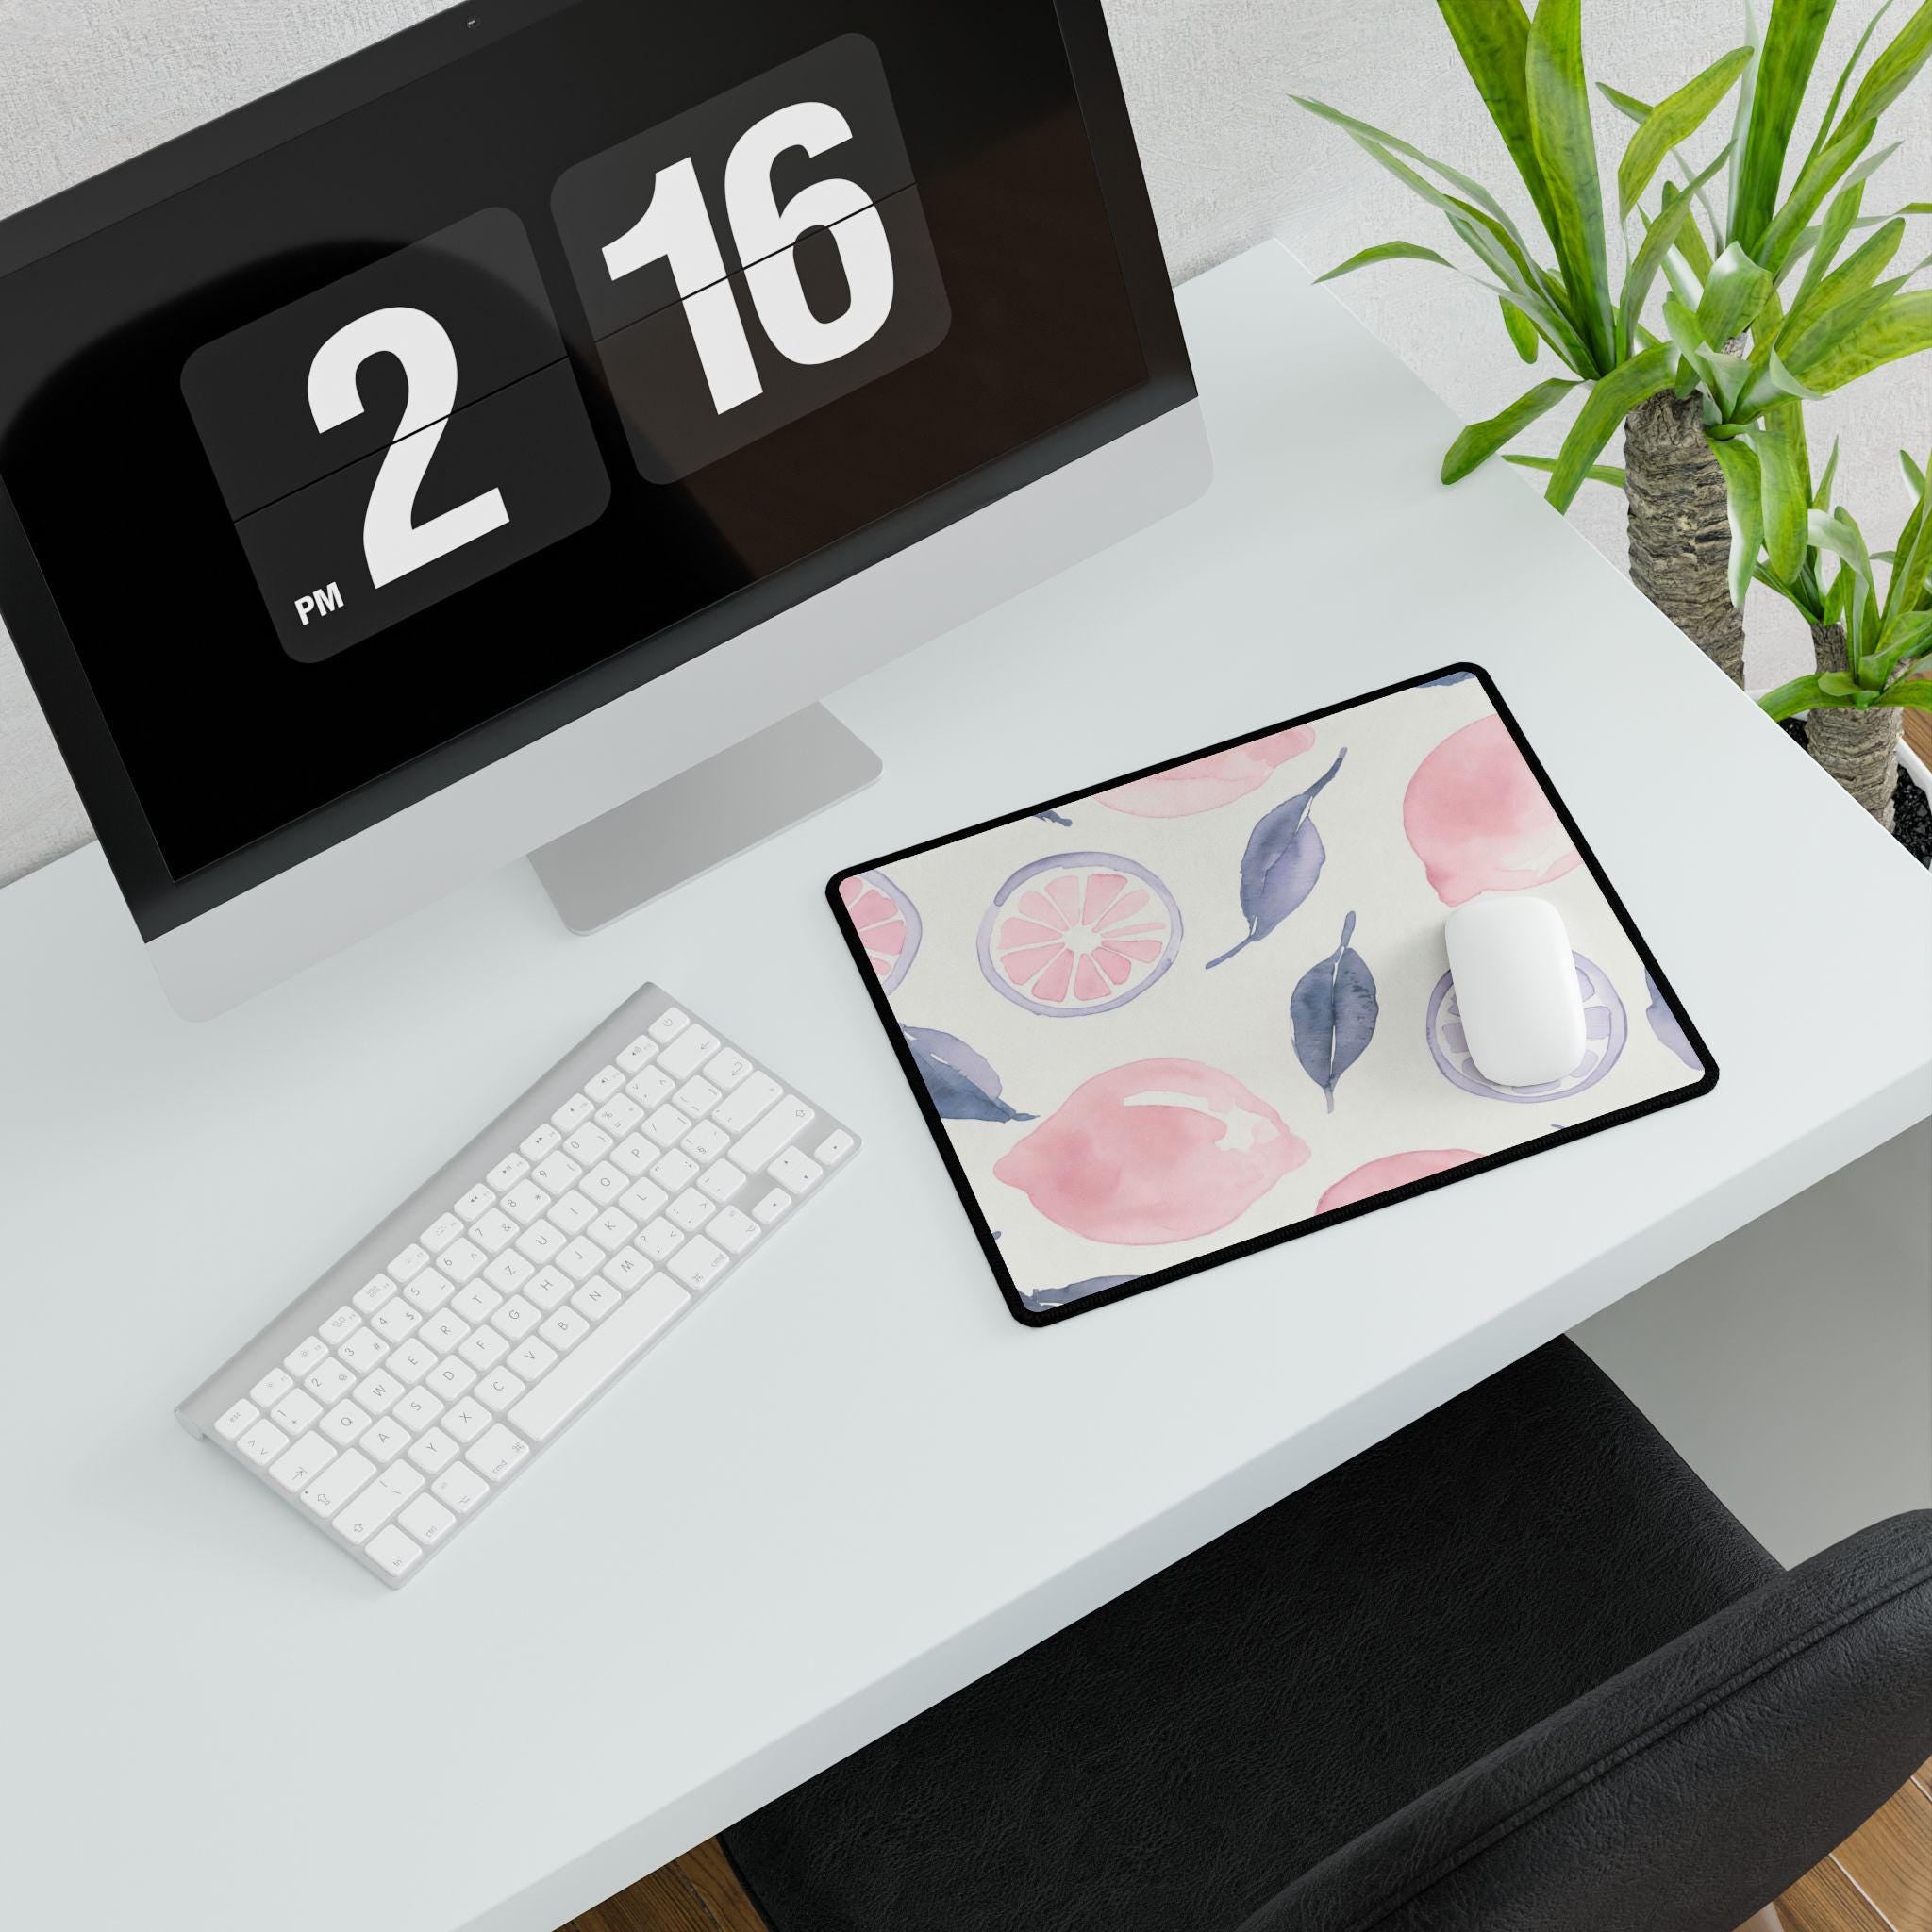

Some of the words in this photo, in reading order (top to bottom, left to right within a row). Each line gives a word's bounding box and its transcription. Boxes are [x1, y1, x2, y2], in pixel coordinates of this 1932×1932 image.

[602, 102, 893, 414] 16
[308, 308, 509, 589] 2
[295, 582, 343, 625] PM
[631, 1148, 640, 1158] P
[601, 1176, 610, 1186] O
[604, 1221, 615, 1230] K
[475, 1228, 482, 1237] 7
[536, 1235, 547, 1245] U
[575, 1250, 583, 1259] J
[505, 1264, 516, 1275] Z
[621, 1259, 634, 1272] M
[540, 1279, 553, 1290] H
[411, 1288, 420, 1296] 5
[589, 1290, 601, 1301] N
[472, 1294, 482, 1303] T
[509, 1309, 520, 1319] G
[440, 1325, 451, 1335] R
[558, 1321, 568, 1330] B
[476, 1340, 485, 1349] F
[344, 1348, 355, 1357] 3
[525, 1350, 534, 1359] V
[408, 1355, 418, 1365] E
[442, 1371, 455, 1380] D
[311, 1378, 322, 1388] 2
[491, 1381, 504, 1391] C
[372, 1384, 385, 1396] W
[411, 1401, 422, 1410] S
[341, 1417, 353, 1427] Q
[459, 1411, 472, 1424] X
[378, 1433, 390, 1443] A
[425, 1442, 437, 1452] Y
